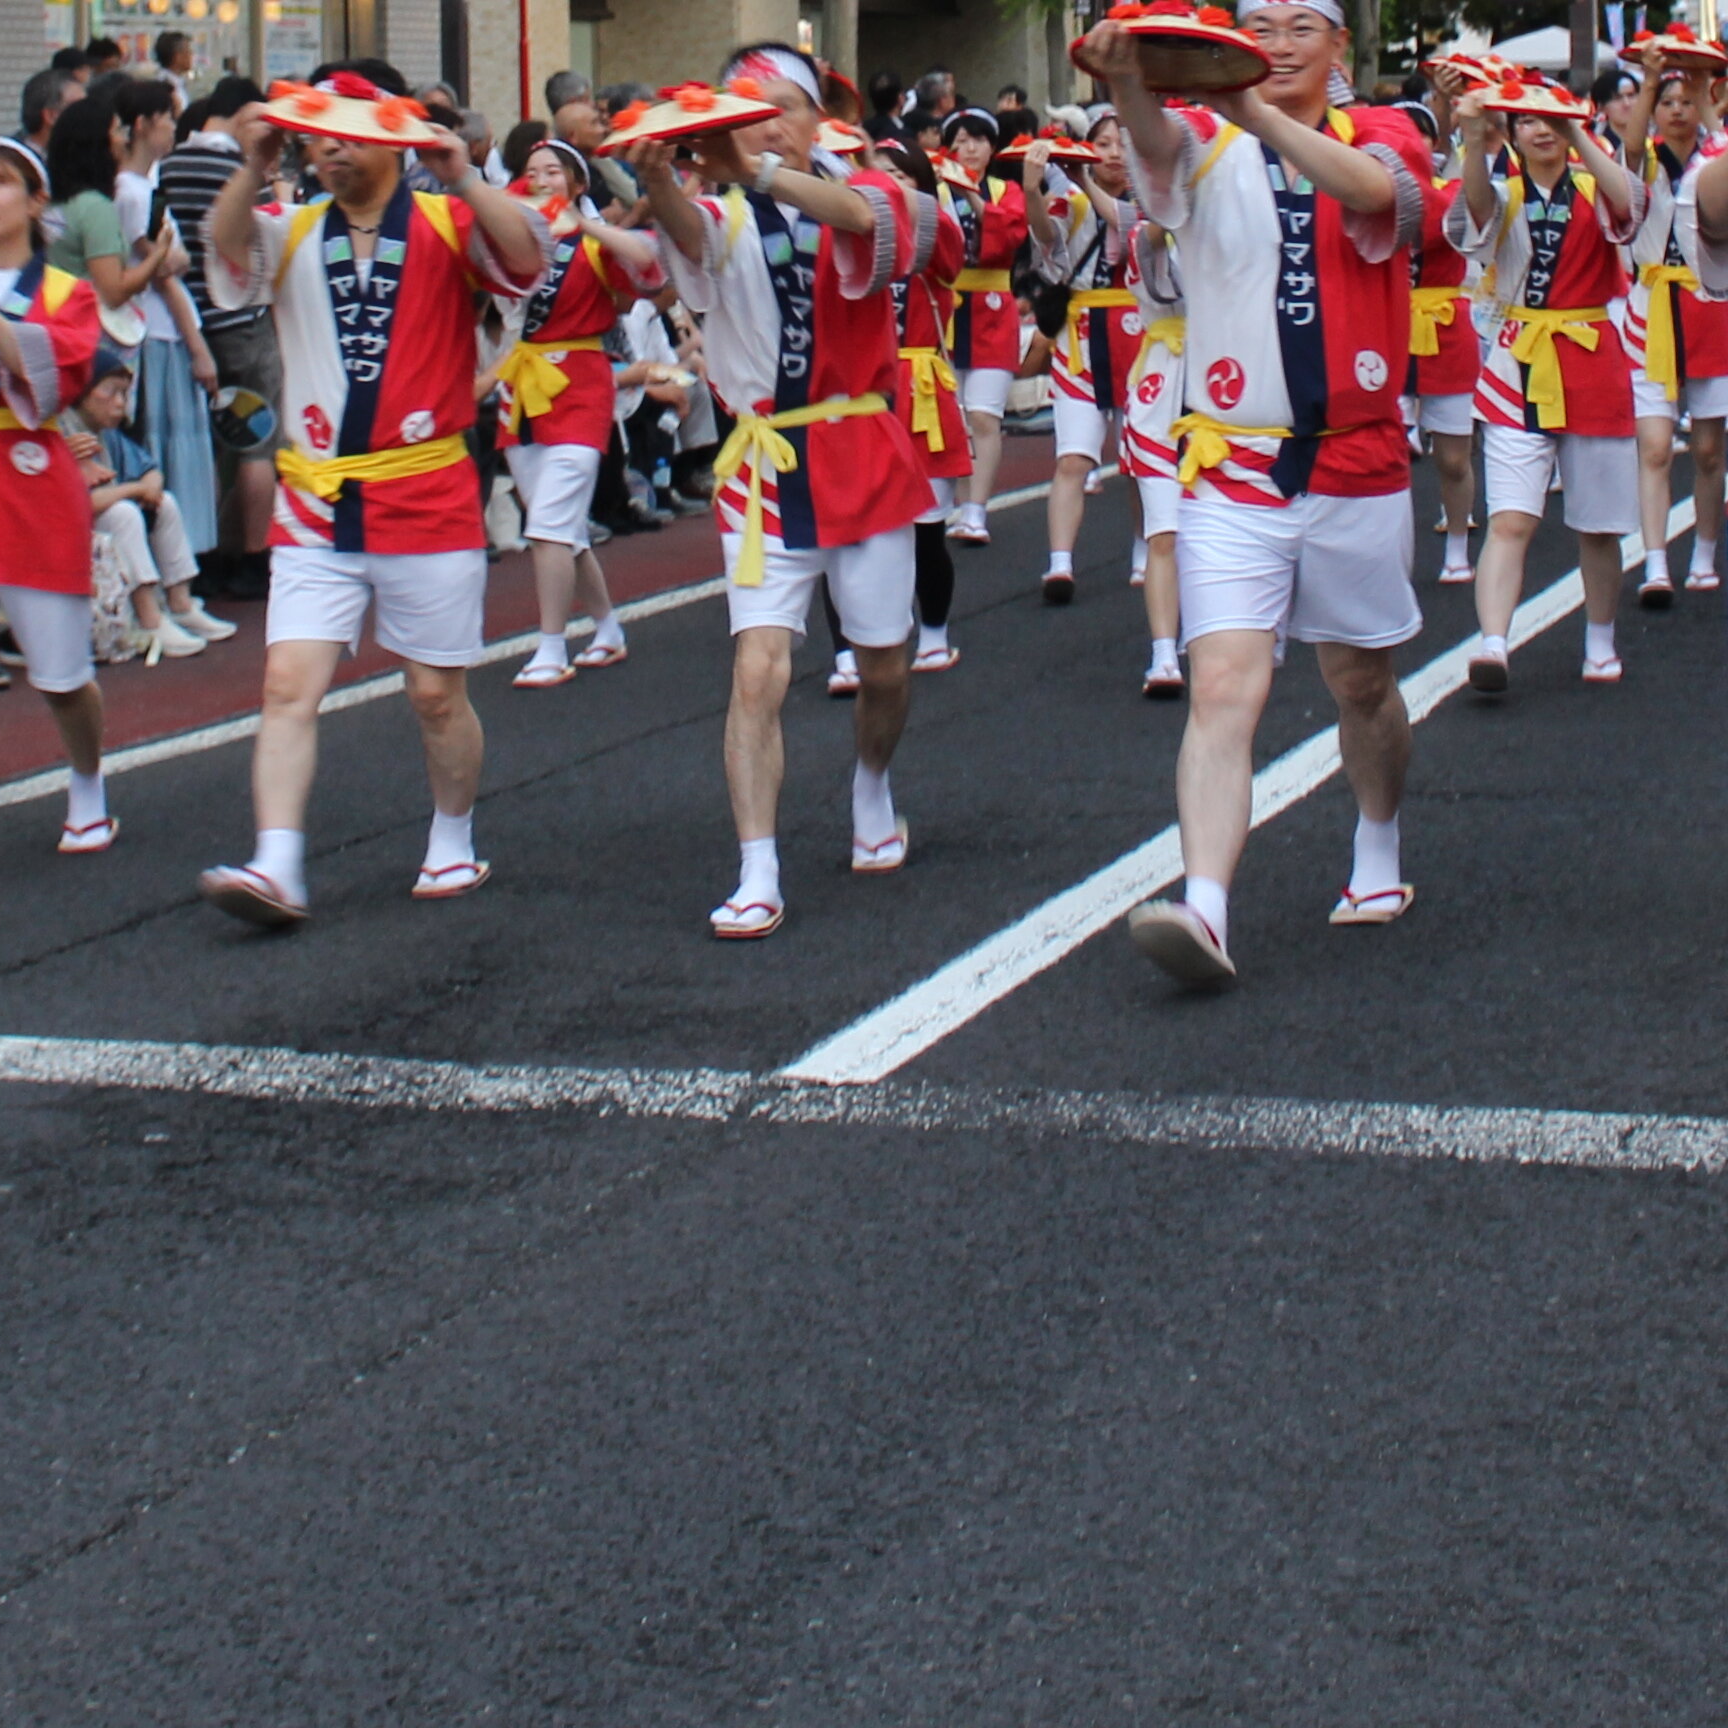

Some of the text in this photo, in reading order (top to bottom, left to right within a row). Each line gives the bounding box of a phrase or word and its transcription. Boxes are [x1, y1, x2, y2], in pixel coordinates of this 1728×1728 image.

[782, 263, 815, 379] ヤマサワ
[1273, 211, 1316, 326] ヤマサワ
[1527, 229, 1561, 306] ヤマサワ
[353, 275, 399, 382] ヤマサワ
